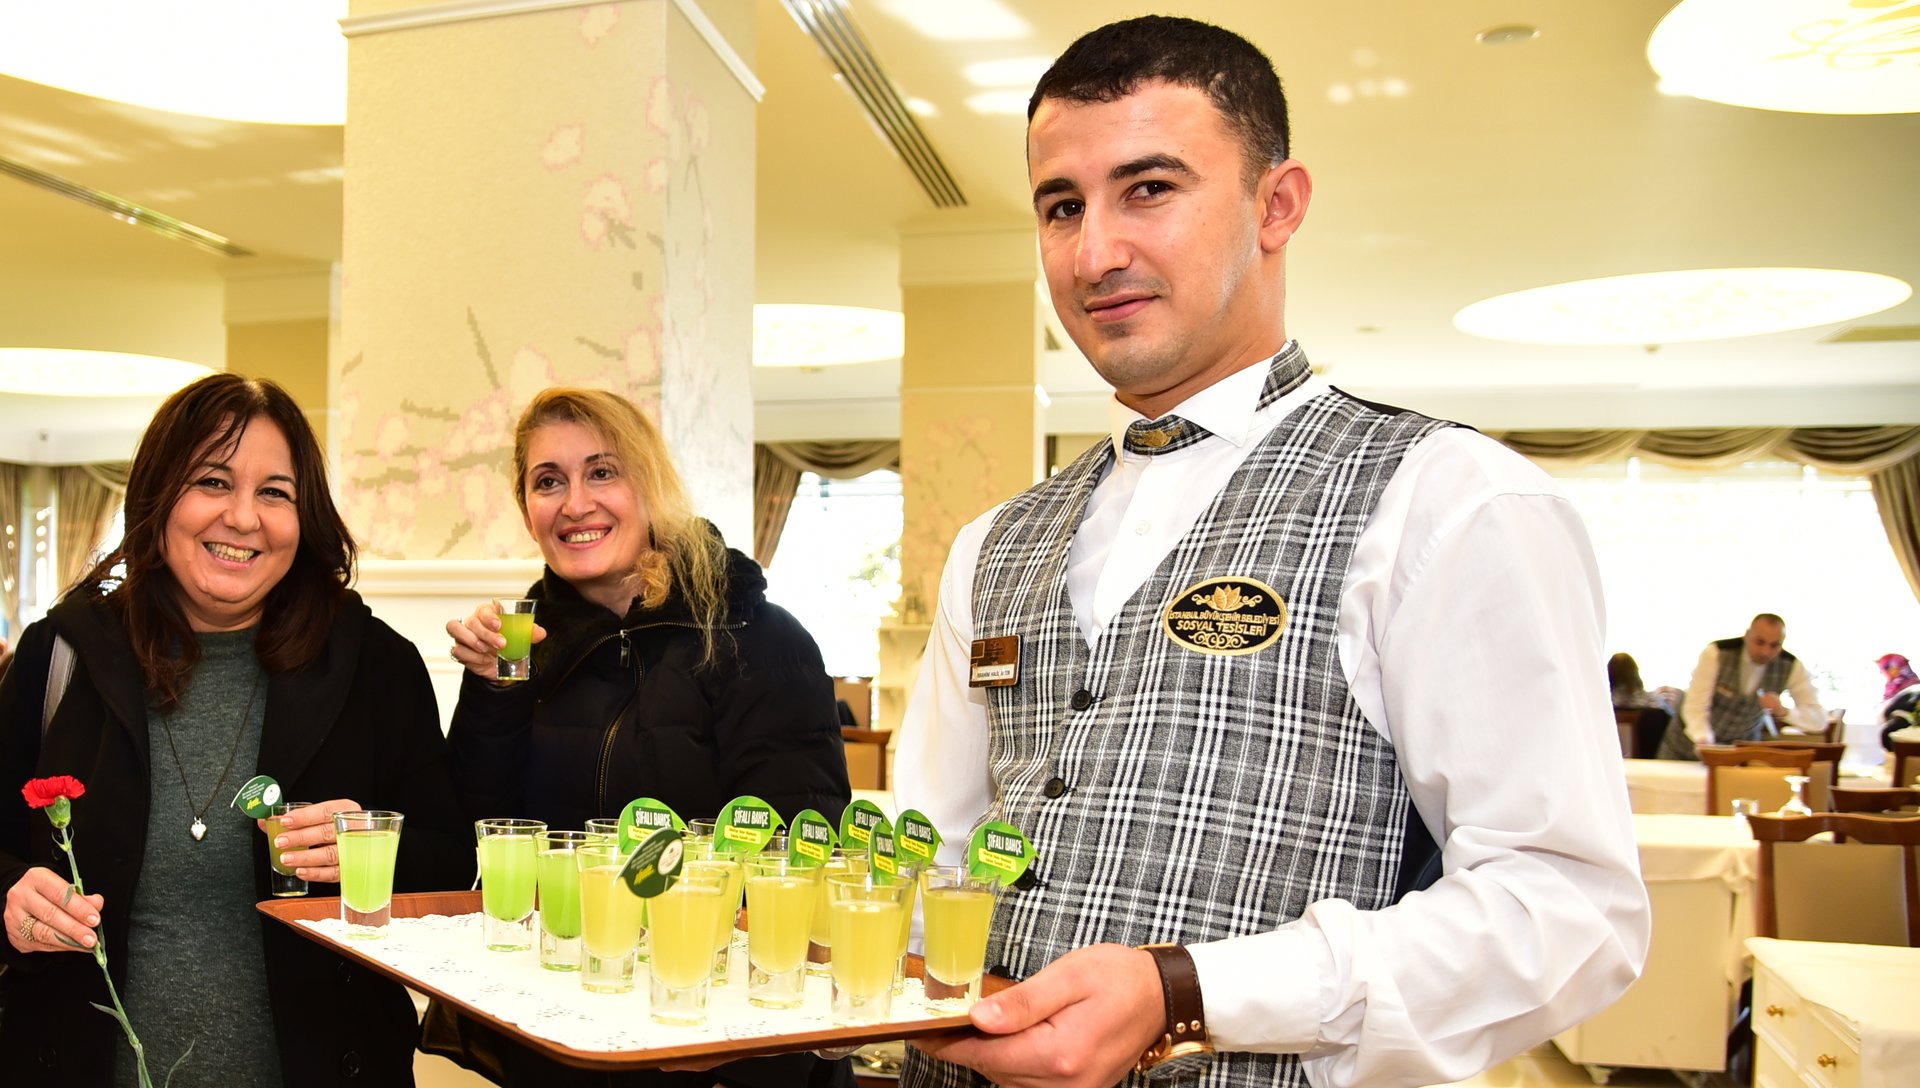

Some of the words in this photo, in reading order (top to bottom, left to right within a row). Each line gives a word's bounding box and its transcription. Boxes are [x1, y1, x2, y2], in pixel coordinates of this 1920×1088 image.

[1176, 619, 1214, 632] SOSYAL
[1217, 621, 1268, 636] TESİSLERİ
[635, 807, 653, 827] ŞİFALI
[653, 812, 671, 829] BAHÇE
[734, 806, 751, 826] ŞİFALI
[751, 810, 769, 828] BAHÇE
[987, 831, 1005, 850] ŞİFALI
[1004, 836, 1023, 856] BAHÇE
